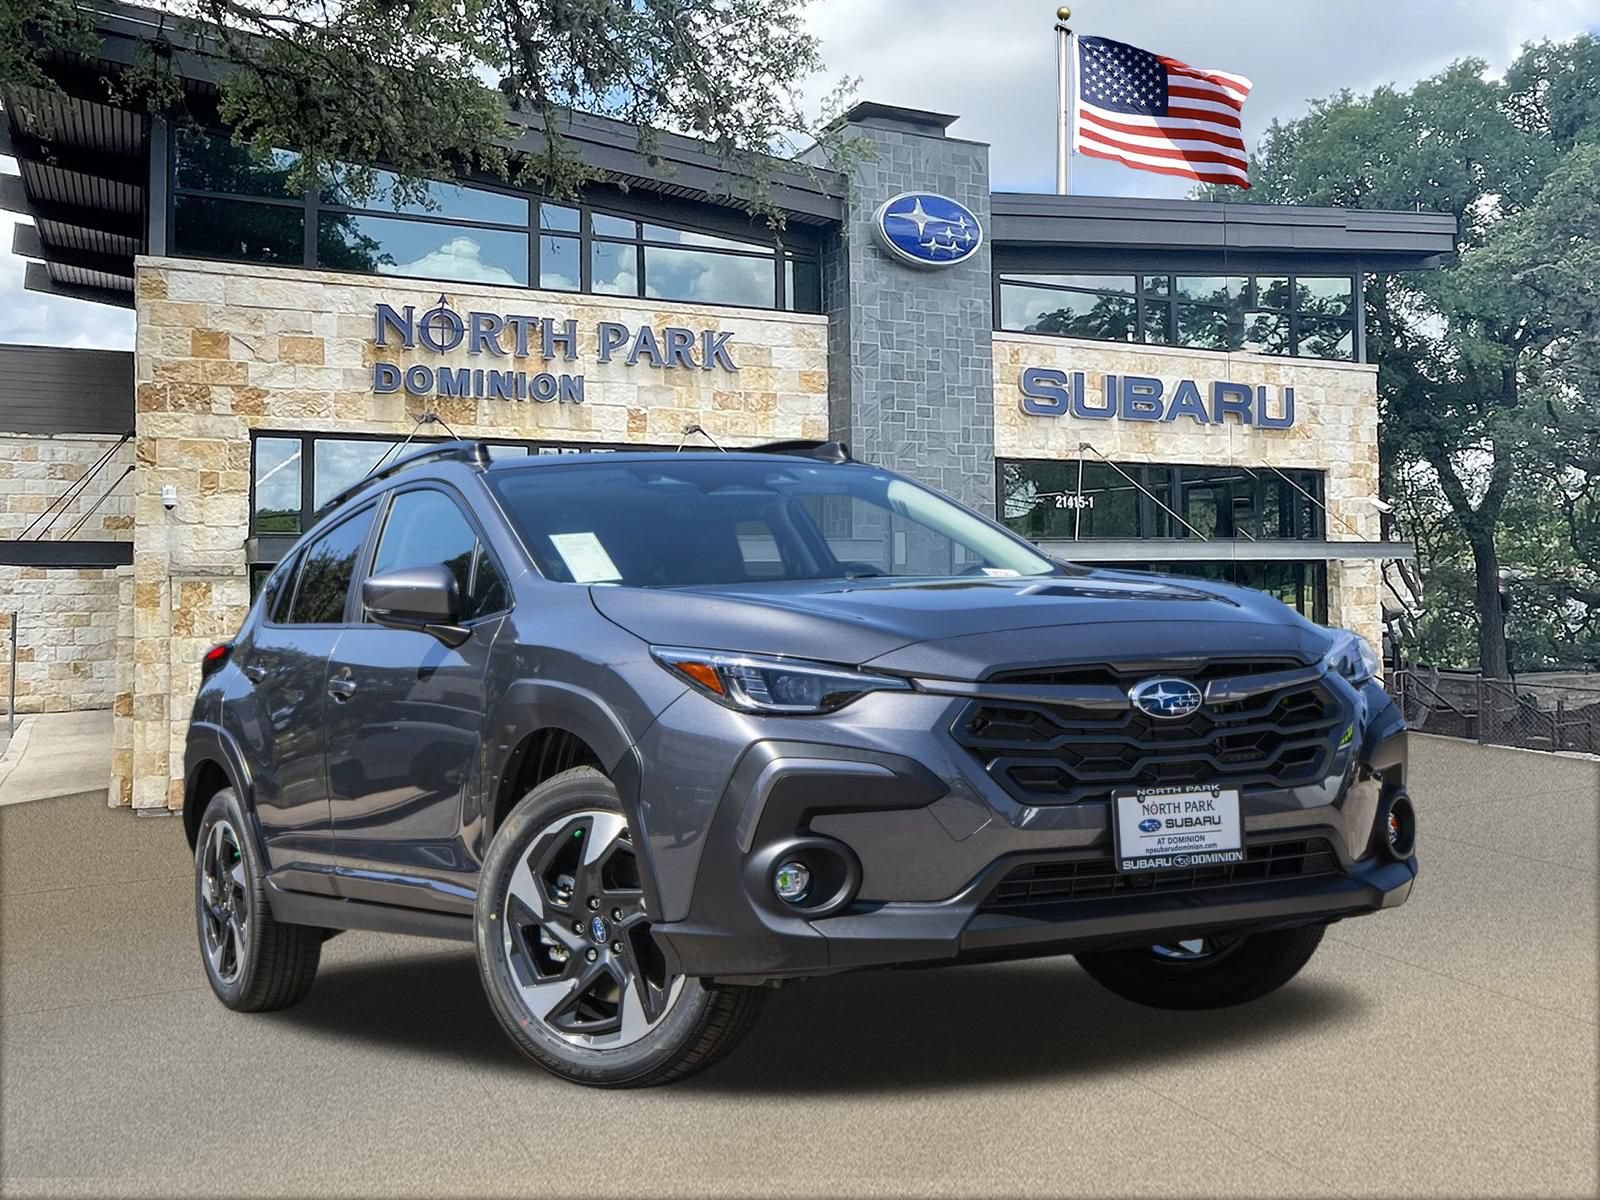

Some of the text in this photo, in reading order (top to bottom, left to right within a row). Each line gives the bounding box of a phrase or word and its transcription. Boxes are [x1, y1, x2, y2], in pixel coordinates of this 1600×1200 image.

[374, 295, 741, 373] NORTH PARK
[373, 362, 584, 404] DOMINION
[1019, 367, 1295, 429] SUBARU
[1055, 495, 1094, 508] 21415-1
[1137, 784, 1220, 796] NORTH PARK
[1142, 799, 1215, 816] NORTH PARK
[1165, 815, 1222, 829] SUBARU
[1167, 834, 1205, 845] DOMINION
[1145, 842, 1218, 855] npsubarudominion.com
[1122, 851, 1243, 870] SUBARU DOMINION
